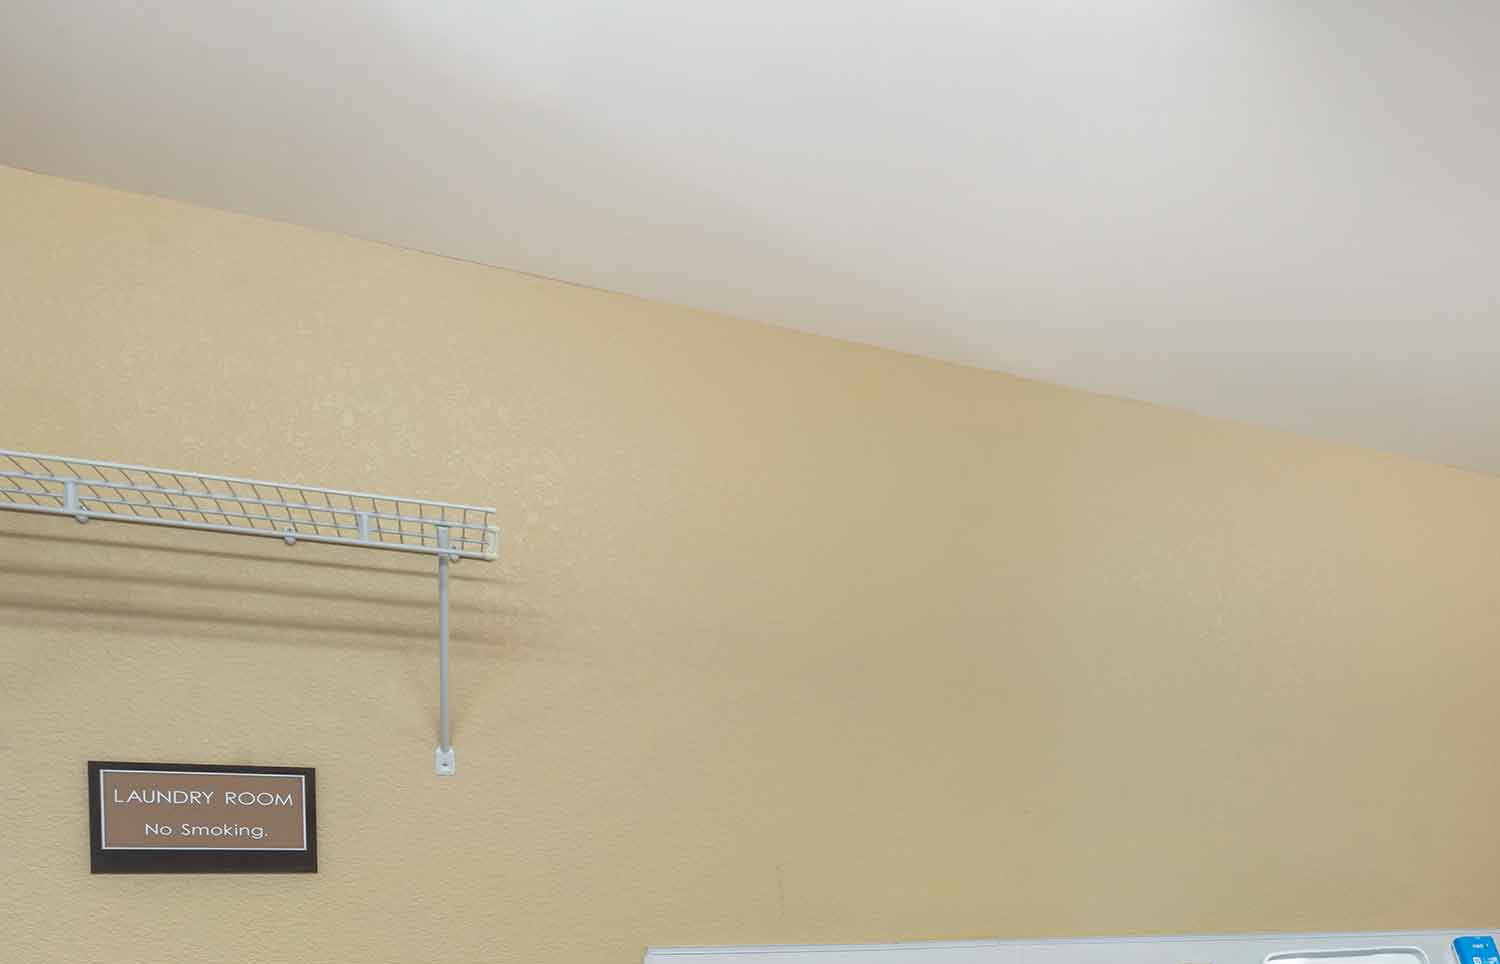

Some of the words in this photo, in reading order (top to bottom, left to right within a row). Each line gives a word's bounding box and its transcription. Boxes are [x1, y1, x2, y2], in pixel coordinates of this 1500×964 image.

[113, 789, 214, 805] LAUNDRY
[224, 791, 293, 806] ROOM
[144, 823, 172, 836] No
[181, 823, 268, 840] Smoking.
